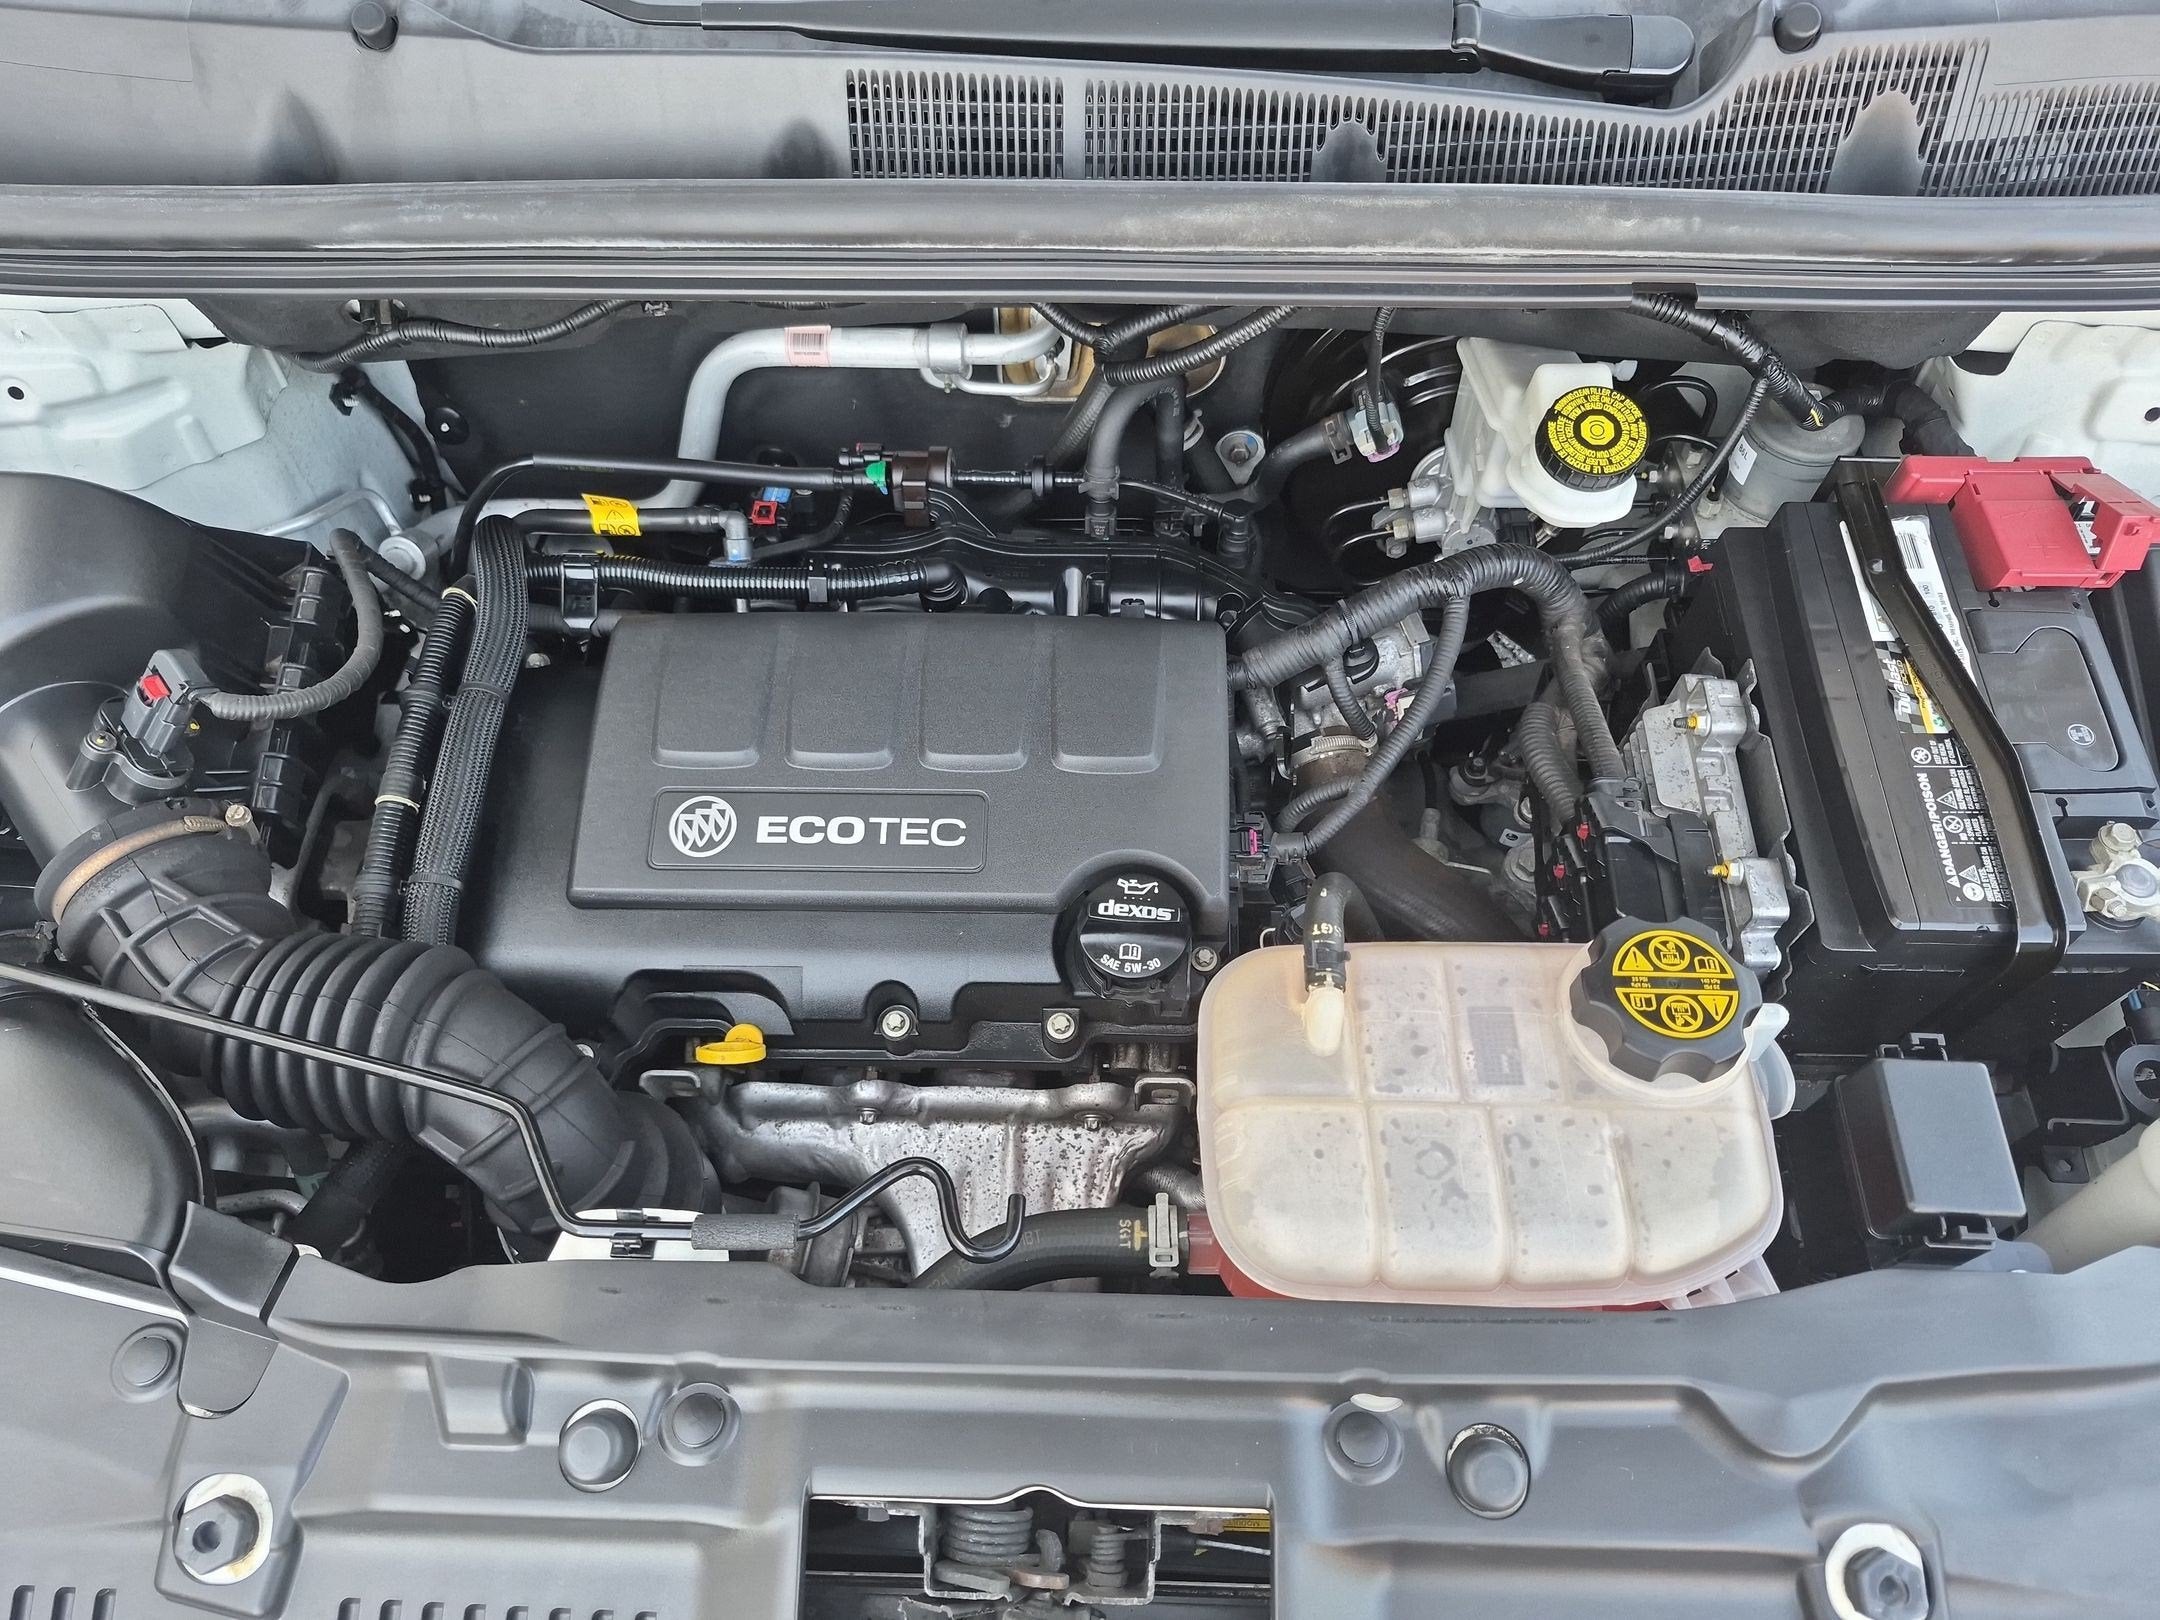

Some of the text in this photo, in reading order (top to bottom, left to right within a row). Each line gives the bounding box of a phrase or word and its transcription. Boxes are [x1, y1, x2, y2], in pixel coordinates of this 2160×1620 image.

[1572, 388, 1589, 398] CLEAN
[1611, 391, 1625, 401] CAP
[1623, 399, 1642, 417] BEFORE
[1584, 402, 1602, 410] SEALED
[1601, 395, 1614, 405] ONLY
[1613, 400, 1623, 409] DOT
[1622, 408, 1636, 422] FLUID
[1895, 659, 1908, 685] GOLD
[1881, 658, 1914, 715] Duralast
[1929, 745, 1939, 754] OUT
[1932, 754, 1942, 764] KEEP
[1936, 743, 1949, 764] THE REACH
[1948, 768, 1957, 777] CAN
[1949, 777, 1961, 787] ACID
[1956, 769, 1974, 809] CAUSE BLINDNESS
[756, 815, 967, 847] ECOTEC
[1916, 772, 1957, 875] DANGER/POISON
[1962, 818, 1975, 836] SPARKS
[1970, 818, 1982, 836] FLAMES
[1978, 846, 1988, 854] CAN
[1981, 855, 1993, 872] GASES
[1982, 883, 1995, 901] SHIELD
[1986, 872, 2003, 902] EXPLOSIVE
[1097, 899, 1175, 921] dexos
[1100, 954, 1161, 973] SAE 5W-30
[1119, 1219, 1131, 1248] SGT
